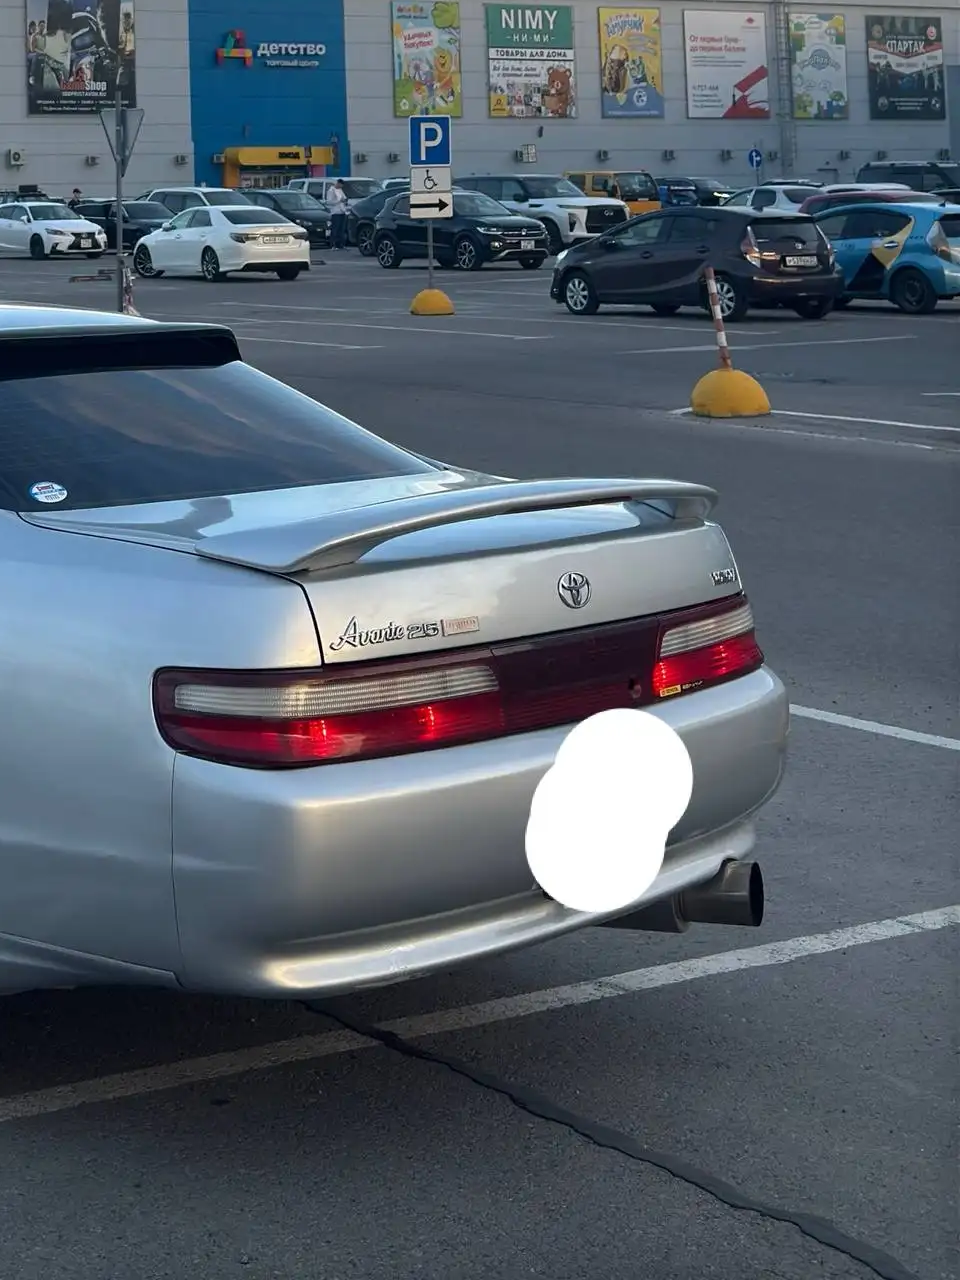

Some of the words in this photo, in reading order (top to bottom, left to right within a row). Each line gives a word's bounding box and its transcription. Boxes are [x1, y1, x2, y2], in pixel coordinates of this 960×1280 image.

[501, 8, 559, 30] NIMY
[257, 43, 327, 57] детство
[495, 49, 527, 58] ТОВАРЫ
[529, 50, 545, 58] ДЛЯ
[546, 50, 568, 58] ДОМА
[886, 40, 925, 53] СПАРТАК
[419, 123, 443, 161] P
[330, 616, 405, 651] Avante
